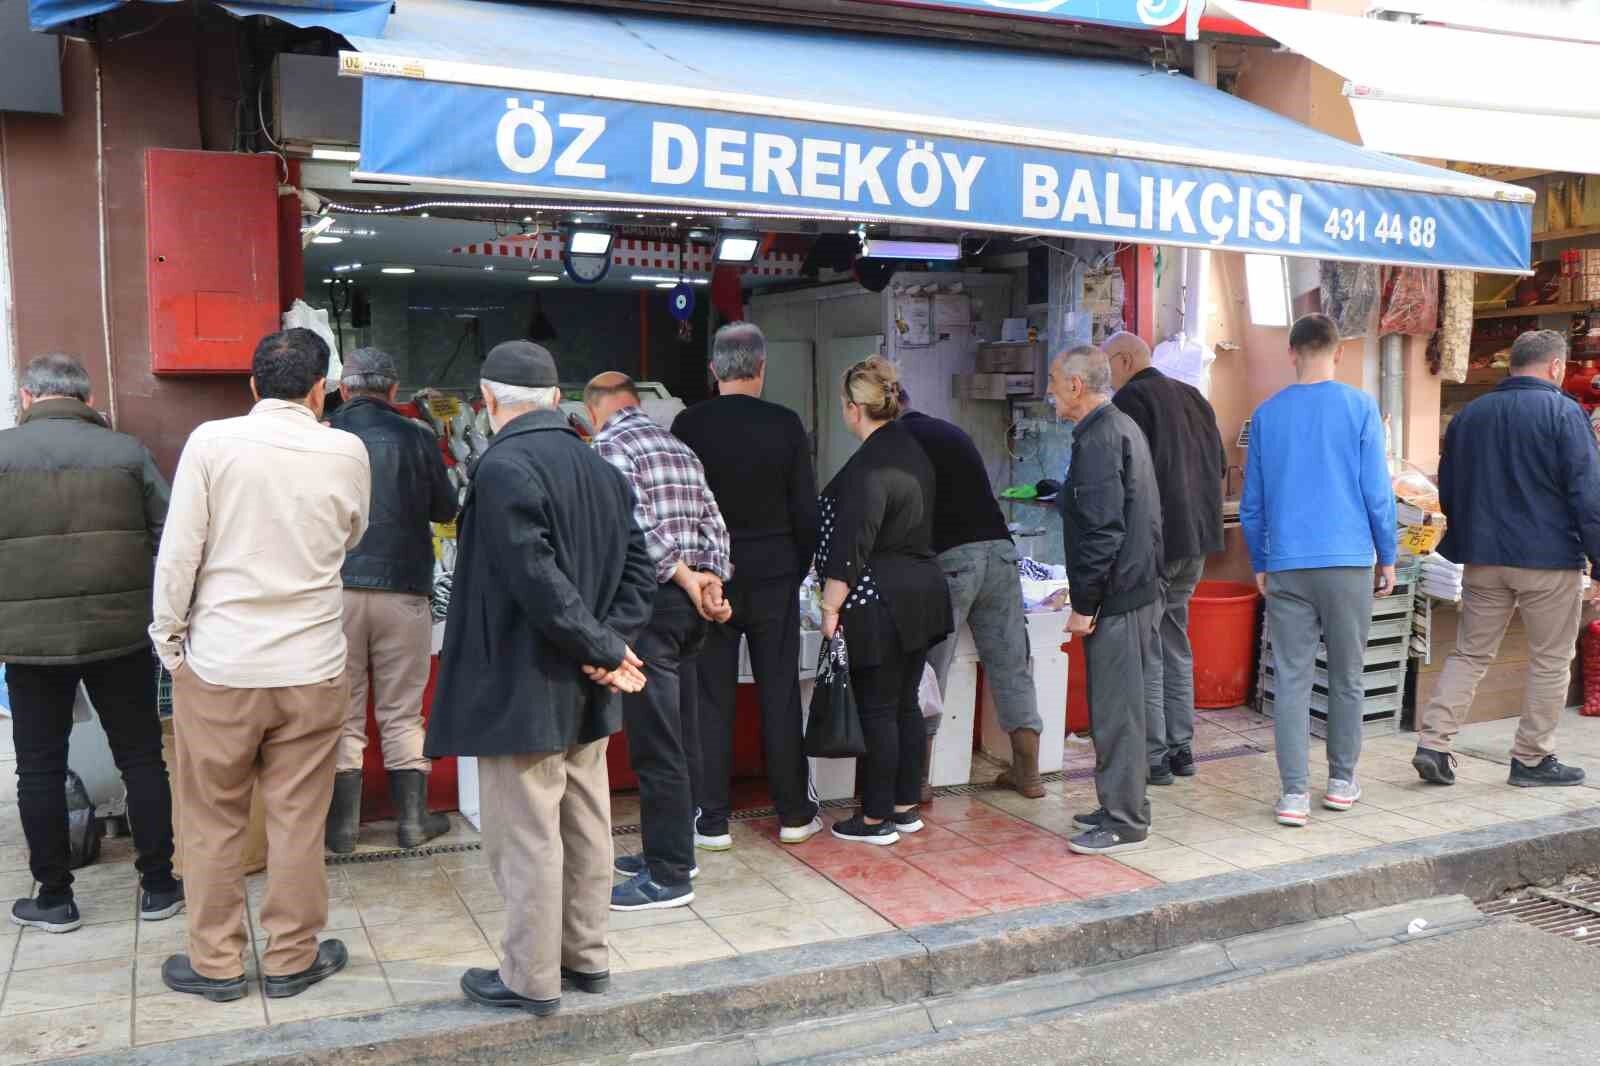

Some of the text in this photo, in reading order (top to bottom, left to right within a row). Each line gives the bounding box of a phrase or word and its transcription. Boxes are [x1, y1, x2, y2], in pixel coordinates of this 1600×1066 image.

[496, 97, 1437, 250] ÖZ DEREKÖY BALIKÇISI 431 44 88
